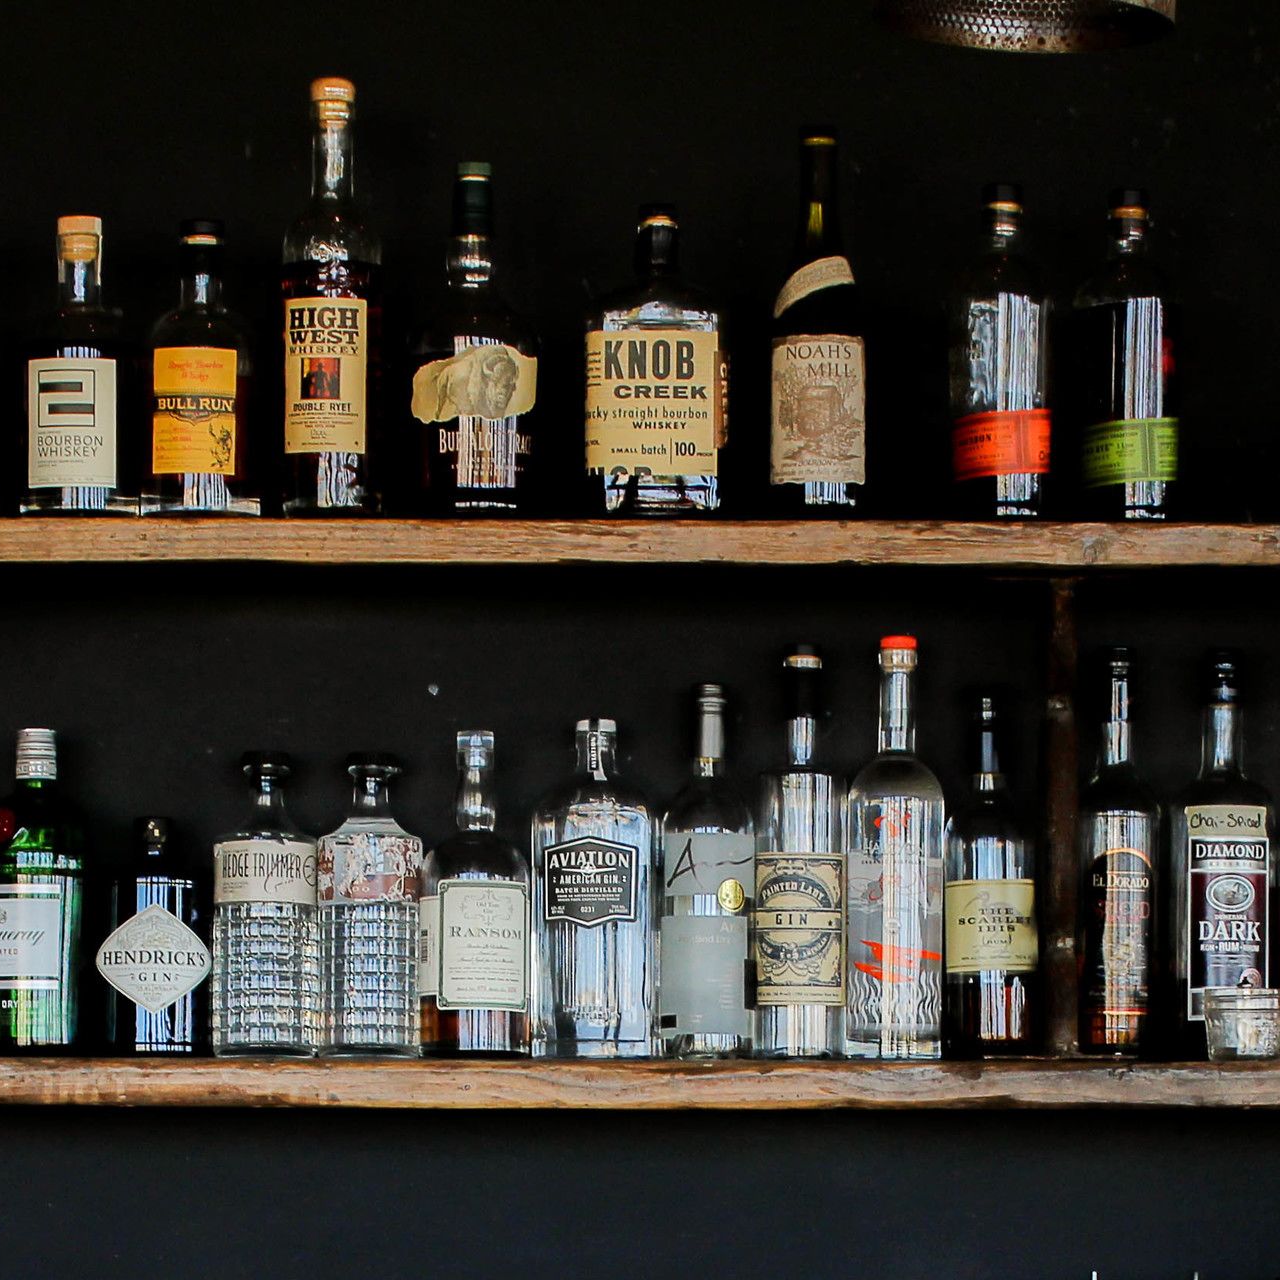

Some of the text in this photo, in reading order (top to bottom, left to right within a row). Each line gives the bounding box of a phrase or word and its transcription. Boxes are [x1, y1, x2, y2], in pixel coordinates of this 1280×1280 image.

[290, 307, 359, 329] HIGH
[290, 330, 359, 344] WEST
[289, 346, 359, 355] WHISKEY
[785, 344, 852, 360] NOAH'S
[604, 339, 694, 380] KNOB
[614, 385, 708, 399] CREEK
[158, 398, 234, 412] BULL RUN
[293, 403, 325, 411] DOUBLE
[612, 406, 708, 420] straight bourbon
[632, 421, 687, 429] WHISKEY
[37, 436, 103, 446] BOURBON
[37, 447, 98, 457] WHISKEY
[641, 444, 667, 455] batch
[675, 442, 696, 456] 100
[1195, 844, 1265, 859] DIAMOND
[222, 852, 302, 879] HEDGE TRIMMER
[549, 851, 629, 869] AVIATION
[560, 875, 601, 884] AMERICAN
[762, 881, 826, 901] PAINTED LADY
[776, 914, 808, 925] GIN
[449, 926, 522, 940] RANSOM
[1199, 921, 1261, 941] DARK
[1219, 942, 1240, 952] RUM
[103, 950, 206, 966] HENDRICK'S
[138, 972, 172, 982] GIN
[2, 1000, 17, 1008] DRY
